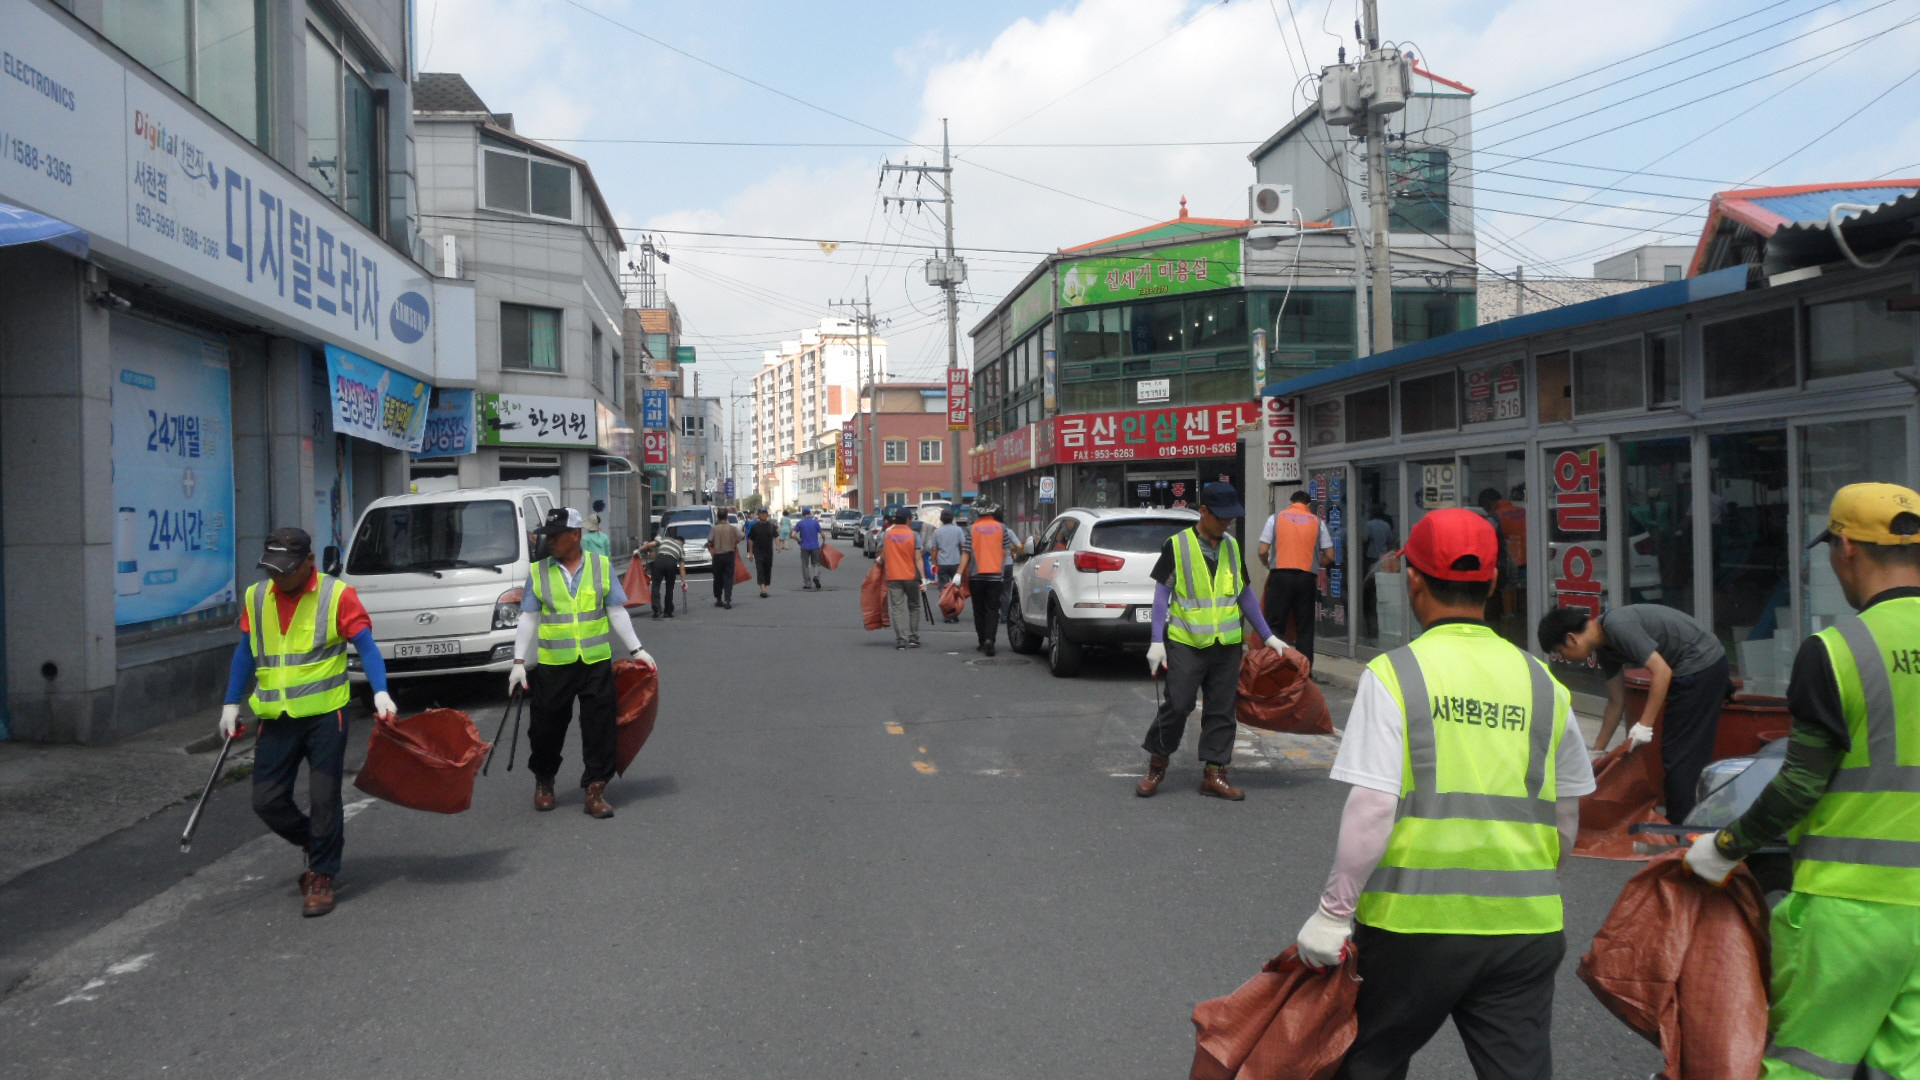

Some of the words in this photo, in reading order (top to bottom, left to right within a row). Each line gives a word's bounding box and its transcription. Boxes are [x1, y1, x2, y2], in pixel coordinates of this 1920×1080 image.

[4, 52, 75, 111] ELECTRONICS
[135, 110, 178, 158] Digital
[11, 138, 72, 187] 1588-3366
[134, 160, 168, 205] 서천점
[135, 202, 175, 239] 953-5959
[182, 226, 220, 260] 1588-3366
[225, 166, 380, 341] 디지털프라자
[1104, 262, 1153, 291] 신세기
[1158, 256, 1208, 283] 미용실
[395, 299, 426, 333] SAMSUNG
[1467, 364, 1521, 399] 얼음
[488, 399, 522, 416] 거북이
[527, 407, 589, 440] 한의원
[645, 397, 663, 421] 치과
[1267, 398, 1297, 458] 얼음
[147, 408, 200, 458] 24개월
[645, 434, 667, 462] 약
[1159, 442, 1238, 457] 010-9510-6263
[1266, 461, 1299, 478] 953-7516
[148, 508, 204, 552] 24시간
[426, 643, 454, 654] 7830
